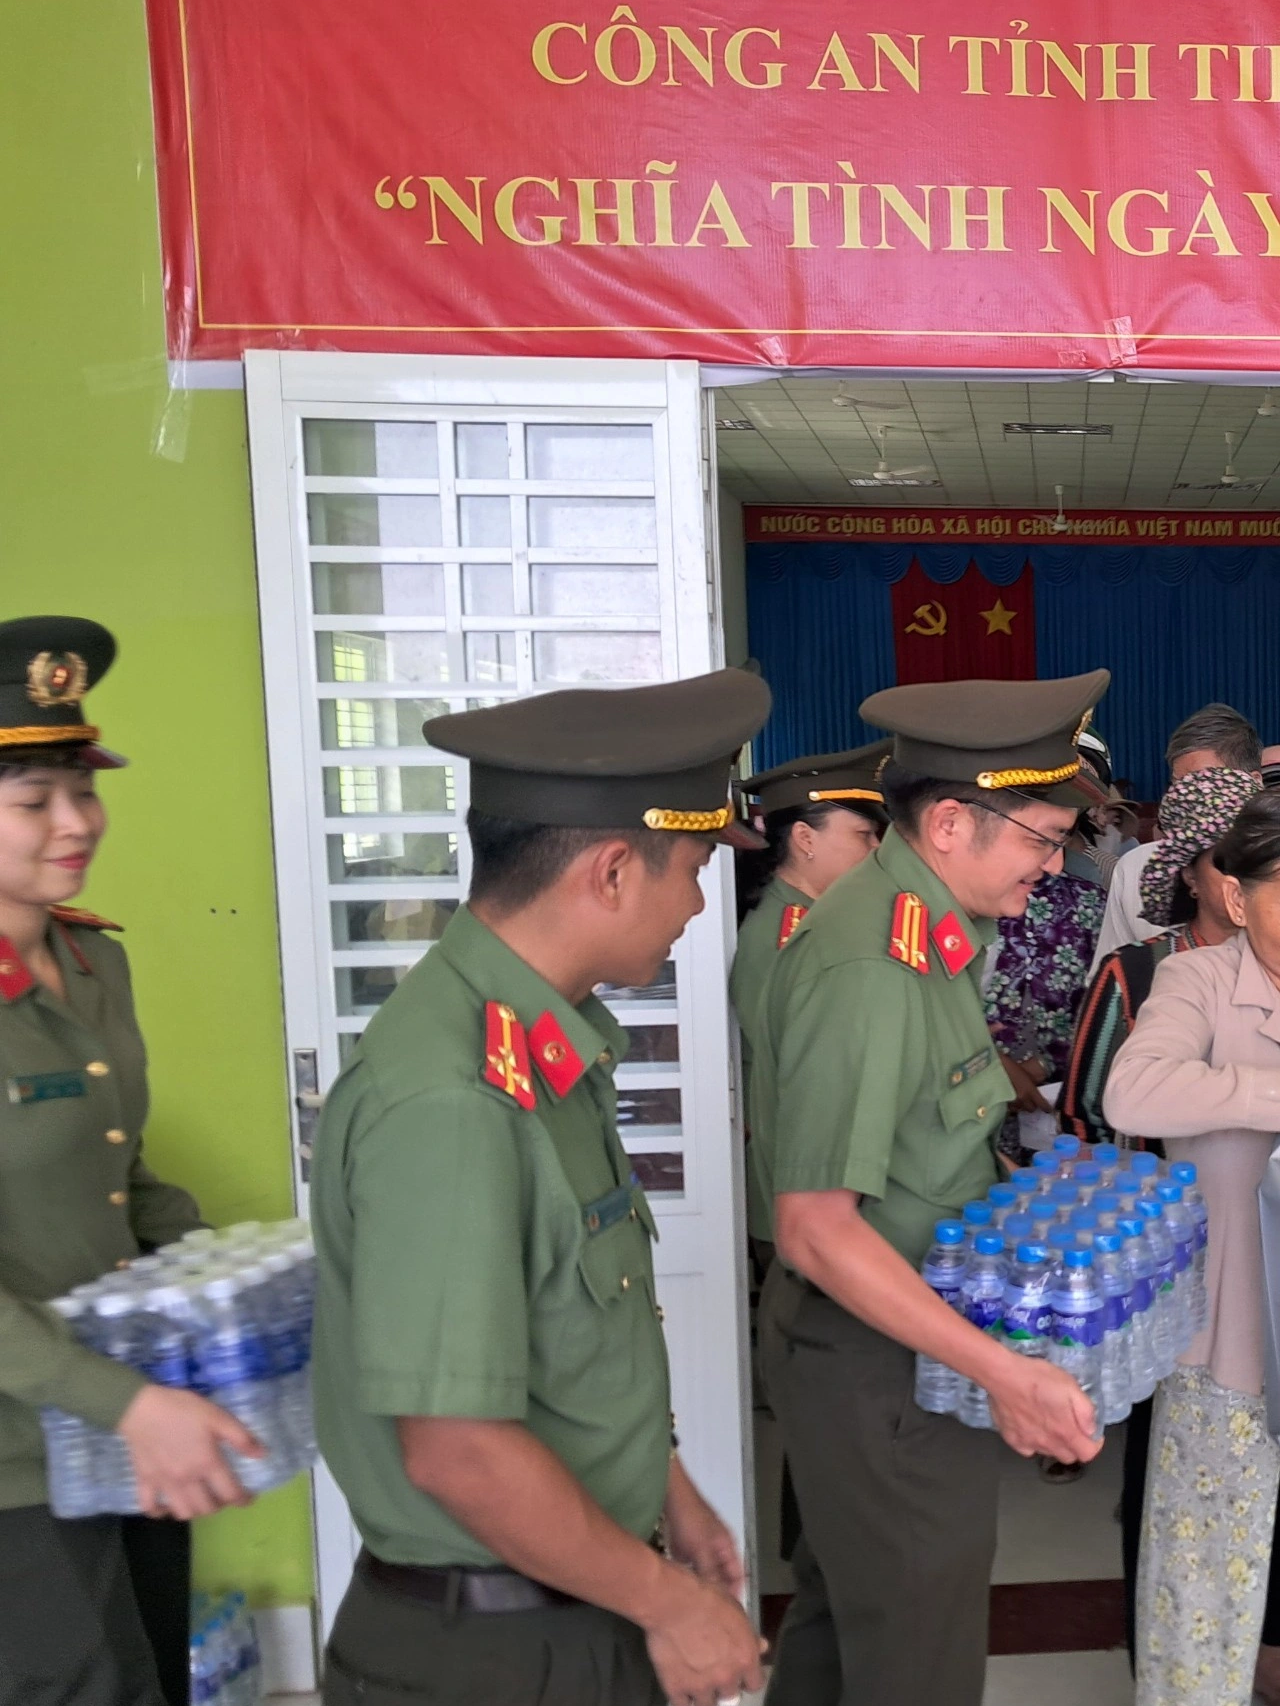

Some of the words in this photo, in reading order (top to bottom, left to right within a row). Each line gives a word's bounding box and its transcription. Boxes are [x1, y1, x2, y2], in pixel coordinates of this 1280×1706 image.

[532, 4, 787, 88] CÔNG
[807, 33, 924, 93] AN
[949, 20, 1157, 101] TỈNH
[374, 159, 752, 249] “NGHĨA
[771, 161, 1013, 252] TÌNH
[760, 513, 821, 533] NƯỚC
[827, 513, 886, 537] CỘNG
[941, 515, 970, 535] XÃ
[976, 515, 1012, 538] HỘI
[1136, 516, 1179, 540] VIỆT
[1184, 520, 1233, 537] NAM
